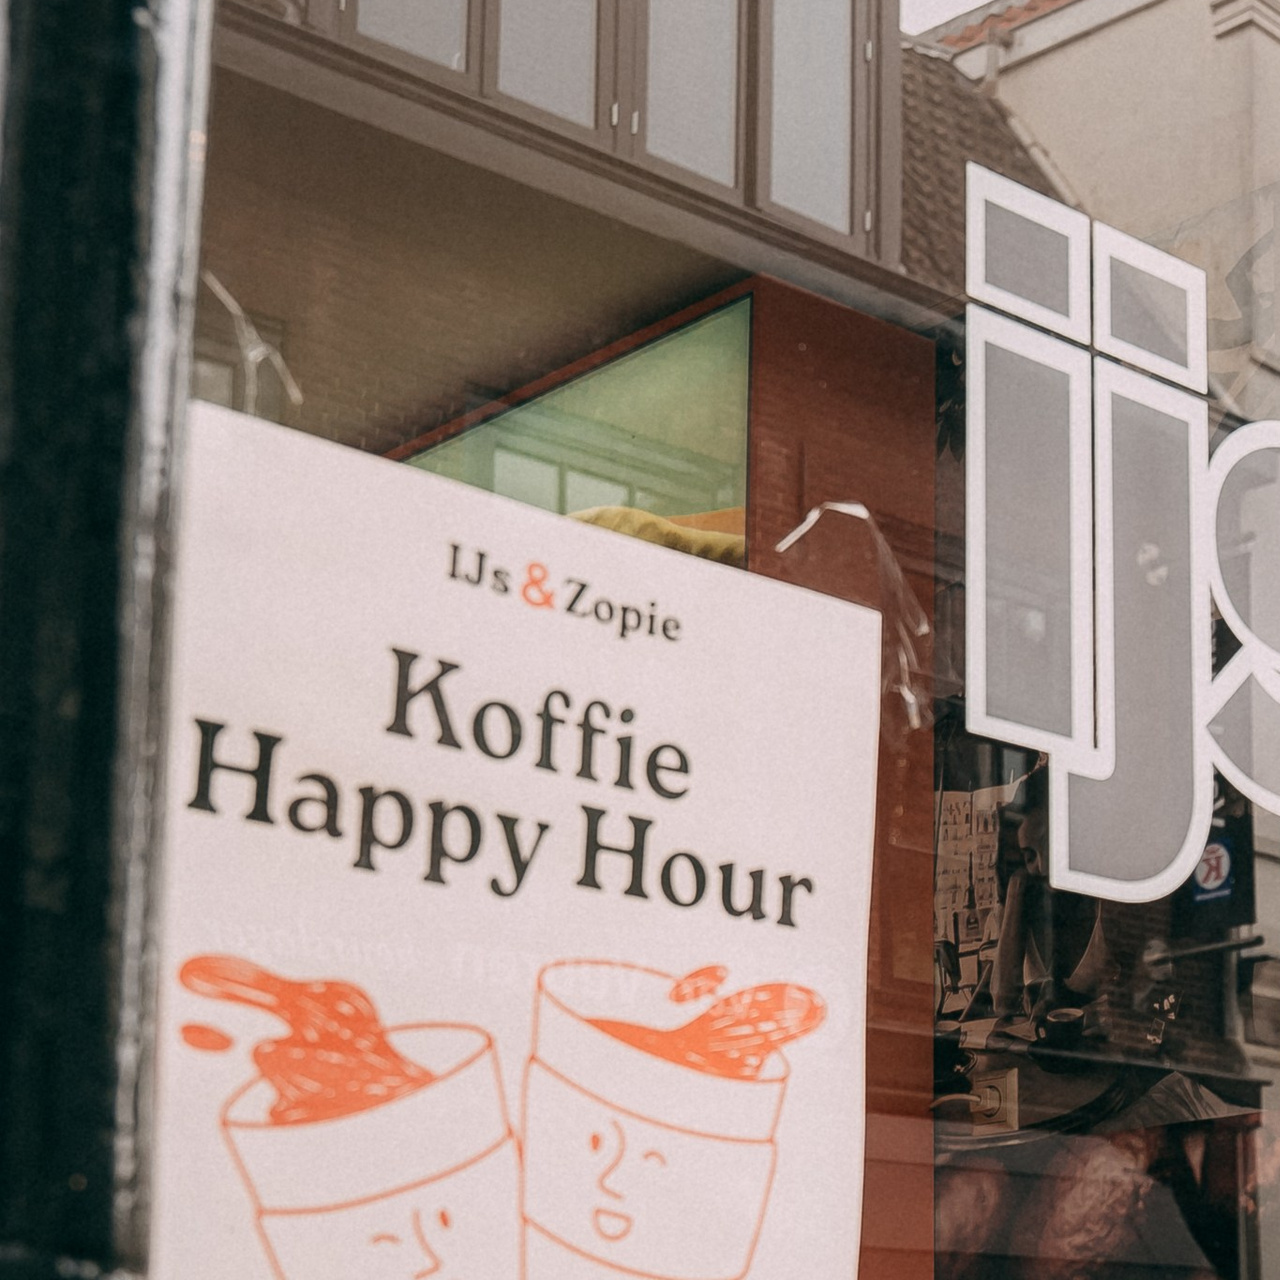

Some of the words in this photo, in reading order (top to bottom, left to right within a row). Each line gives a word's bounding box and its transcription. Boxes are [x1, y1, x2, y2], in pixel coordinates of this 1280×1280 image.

[386, 647, 690, 800] Koffie
[187, 717, 550, 898] Happy
[576, 804, 813, 927] Hour
